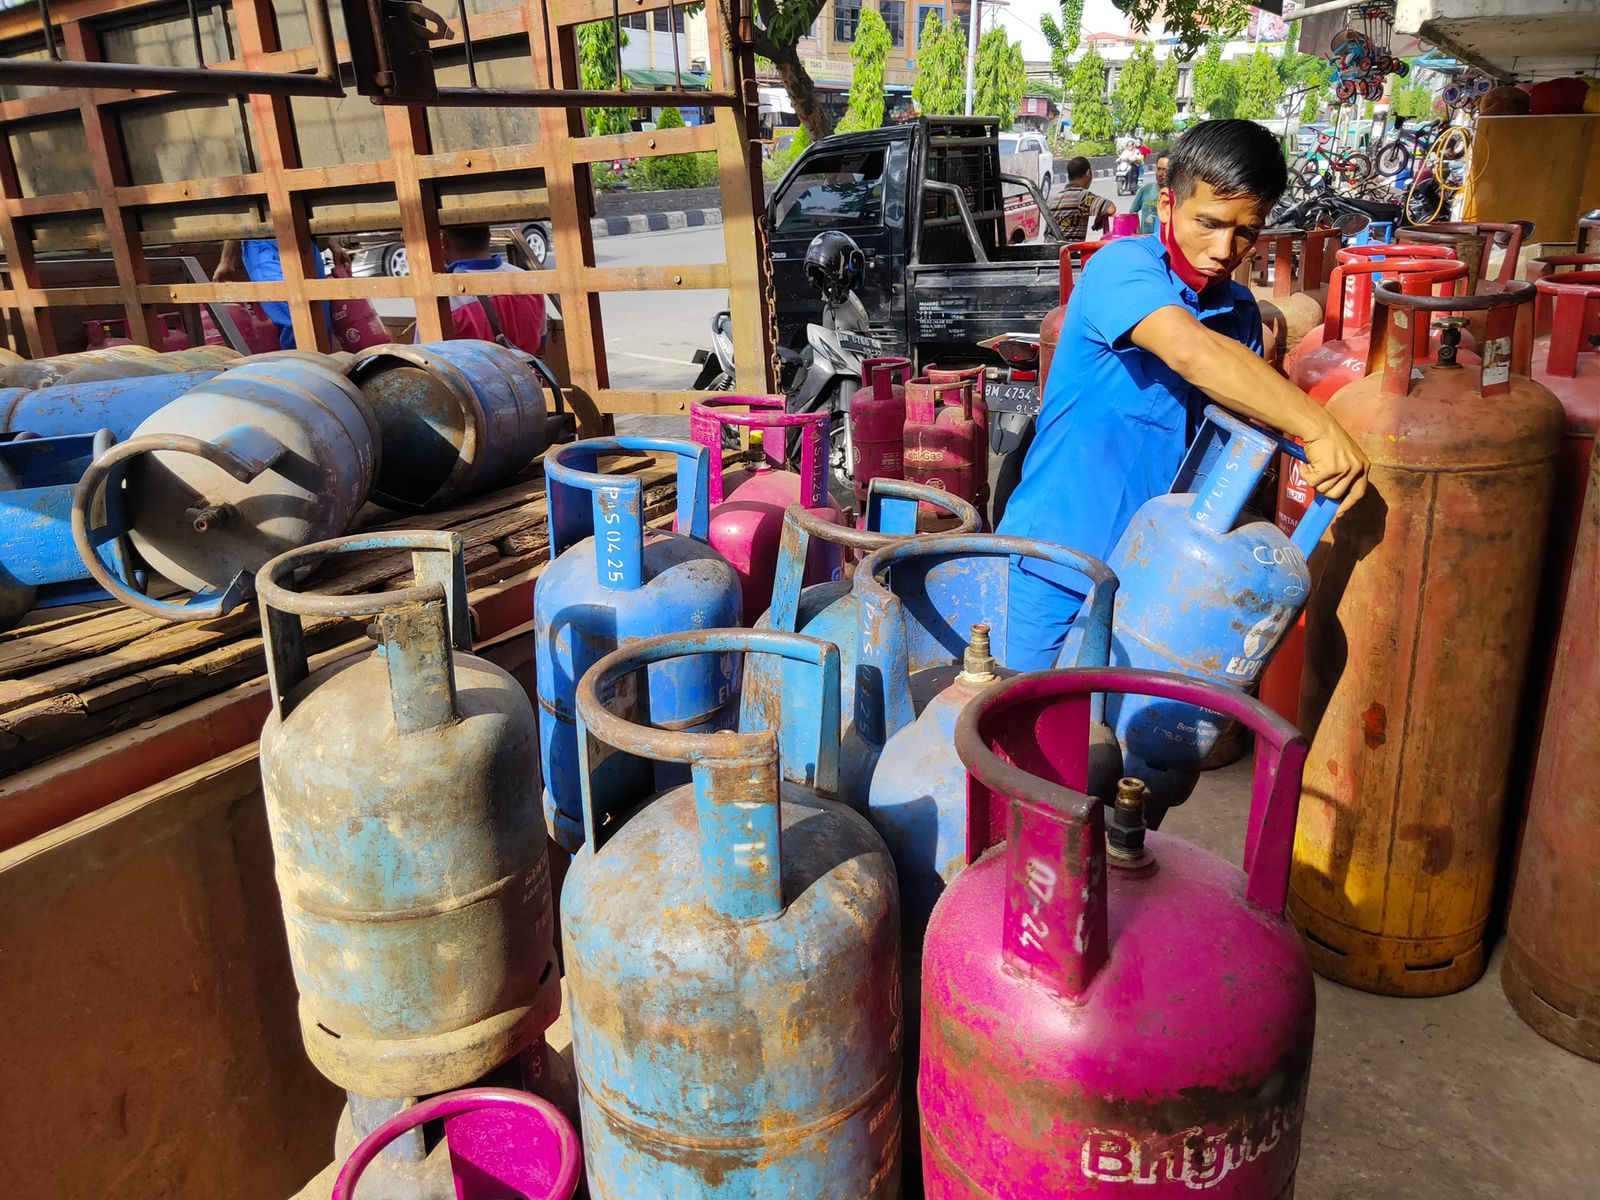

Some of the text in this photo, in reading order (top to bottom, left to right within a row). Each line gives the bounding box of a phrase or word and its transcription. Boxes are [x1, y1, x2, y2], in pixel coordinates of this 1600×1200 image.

[1341, 357, 1367, 372] KG
[985, 385, 999, 397] BM
[1004, 387, 1032, 400] 4754
[922, 450, 944, 461] Gas
[607, 558, 624, 582] 25
